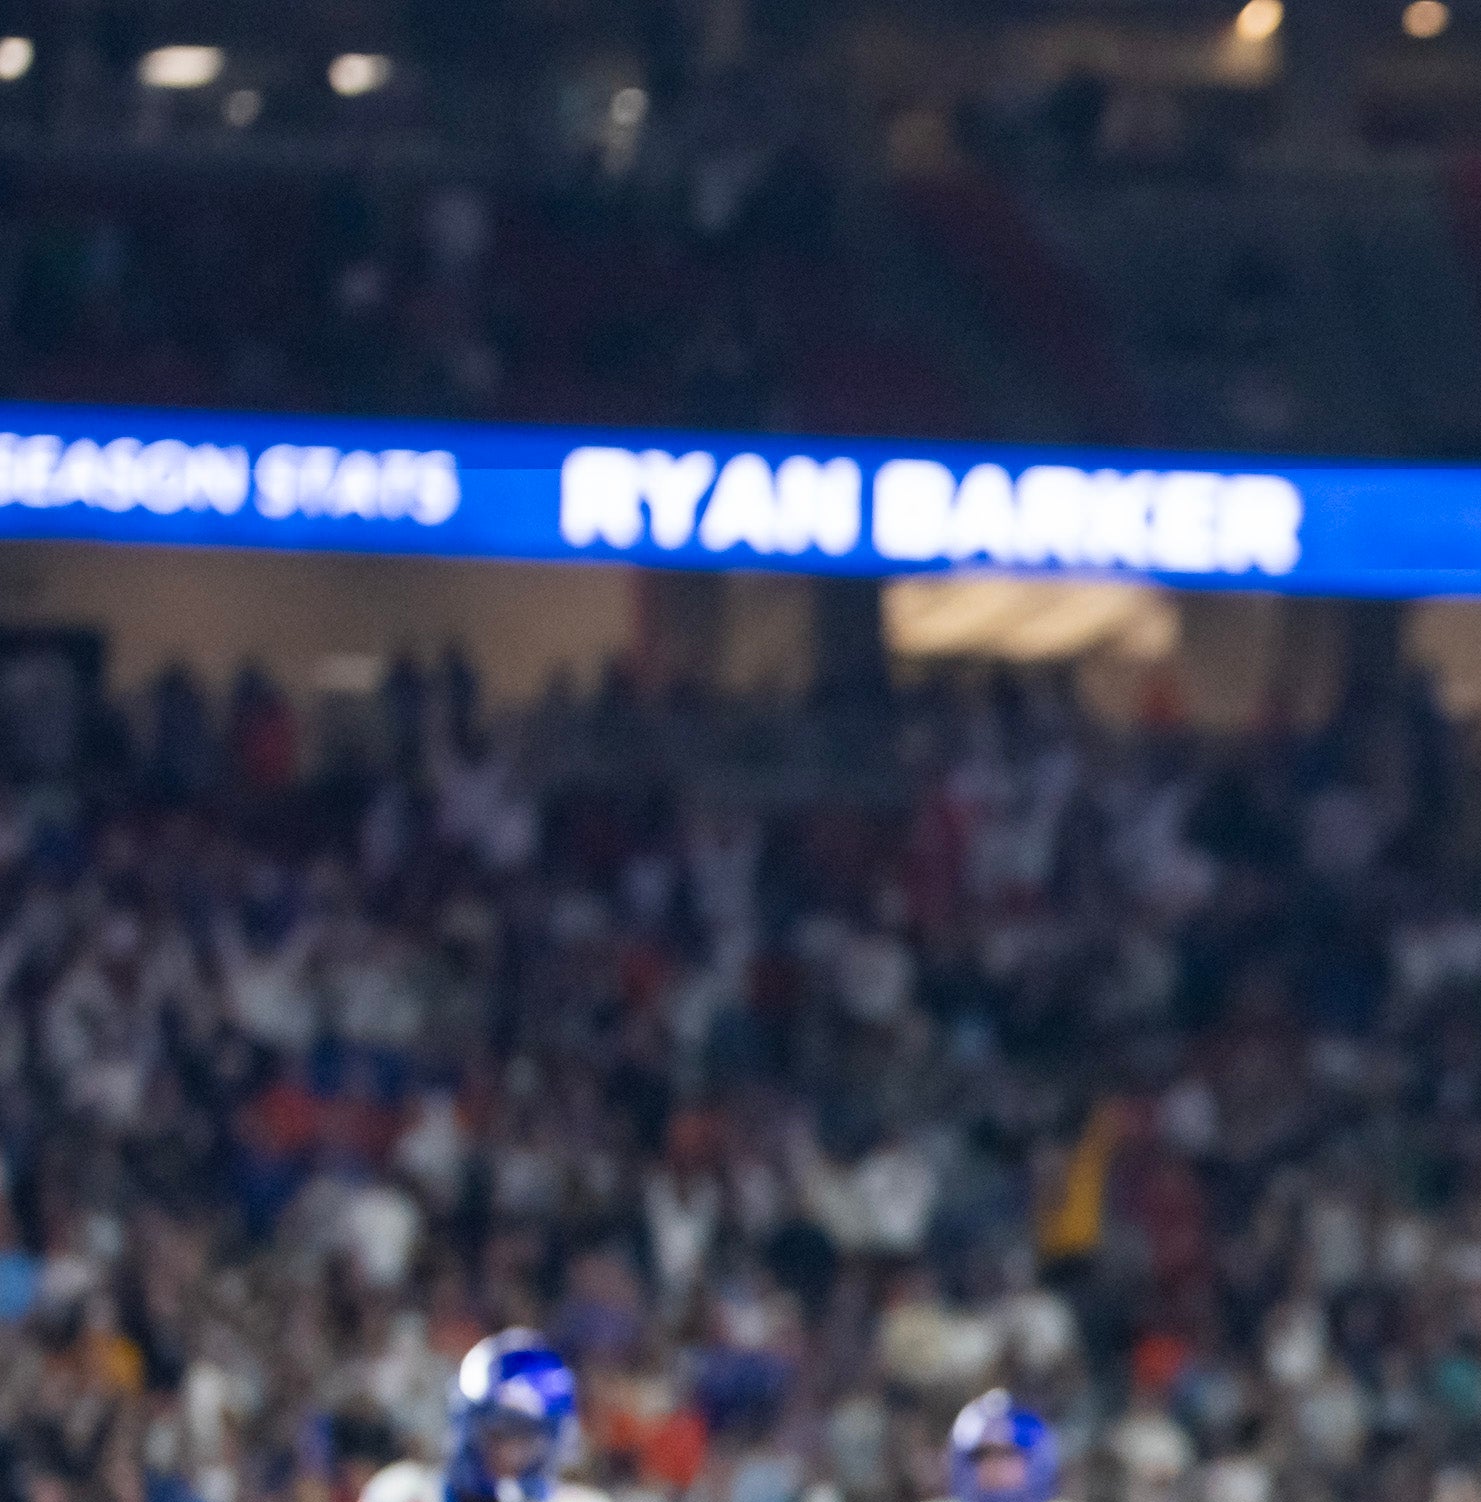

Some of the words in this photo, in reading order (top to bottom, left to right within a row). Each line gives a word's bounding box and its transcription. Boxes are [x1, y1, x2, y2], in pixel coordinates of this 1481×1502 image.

[253, 443, 461, 526] STATS
[559, 445, 863, 557] RYAN
[872, 458, 1302, 576] BARKER
